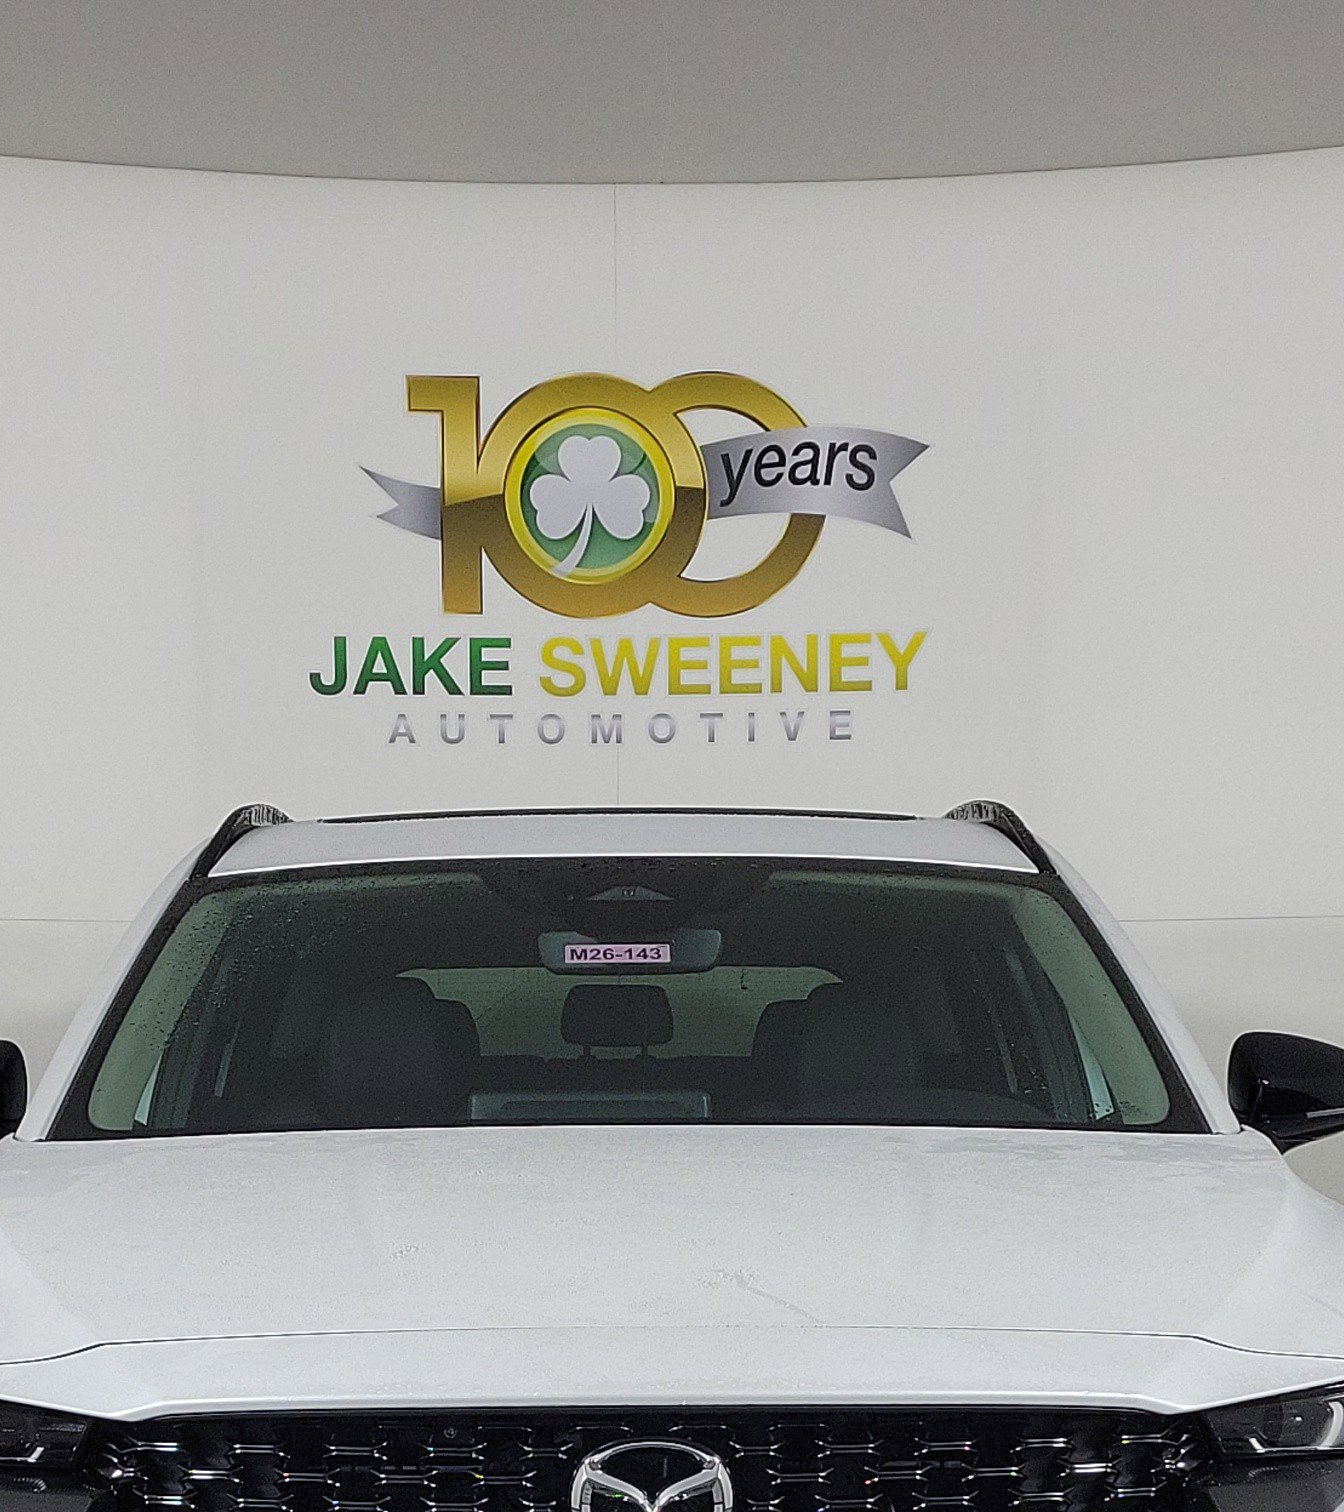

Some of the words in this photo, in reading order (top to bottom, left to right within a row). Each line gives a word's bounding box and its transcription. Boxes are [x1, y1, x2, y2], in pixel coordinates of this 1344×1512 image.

[406, 371, 825, 618] 100
[719, 439, 878, 507] years
[309, 635, 513, 698] JAKE
[538, 630, 928, 698] SWEENEY
[388, 709, 853, 745] AUTOMOTIVE
[569, 947, 663, 961] M26-143
